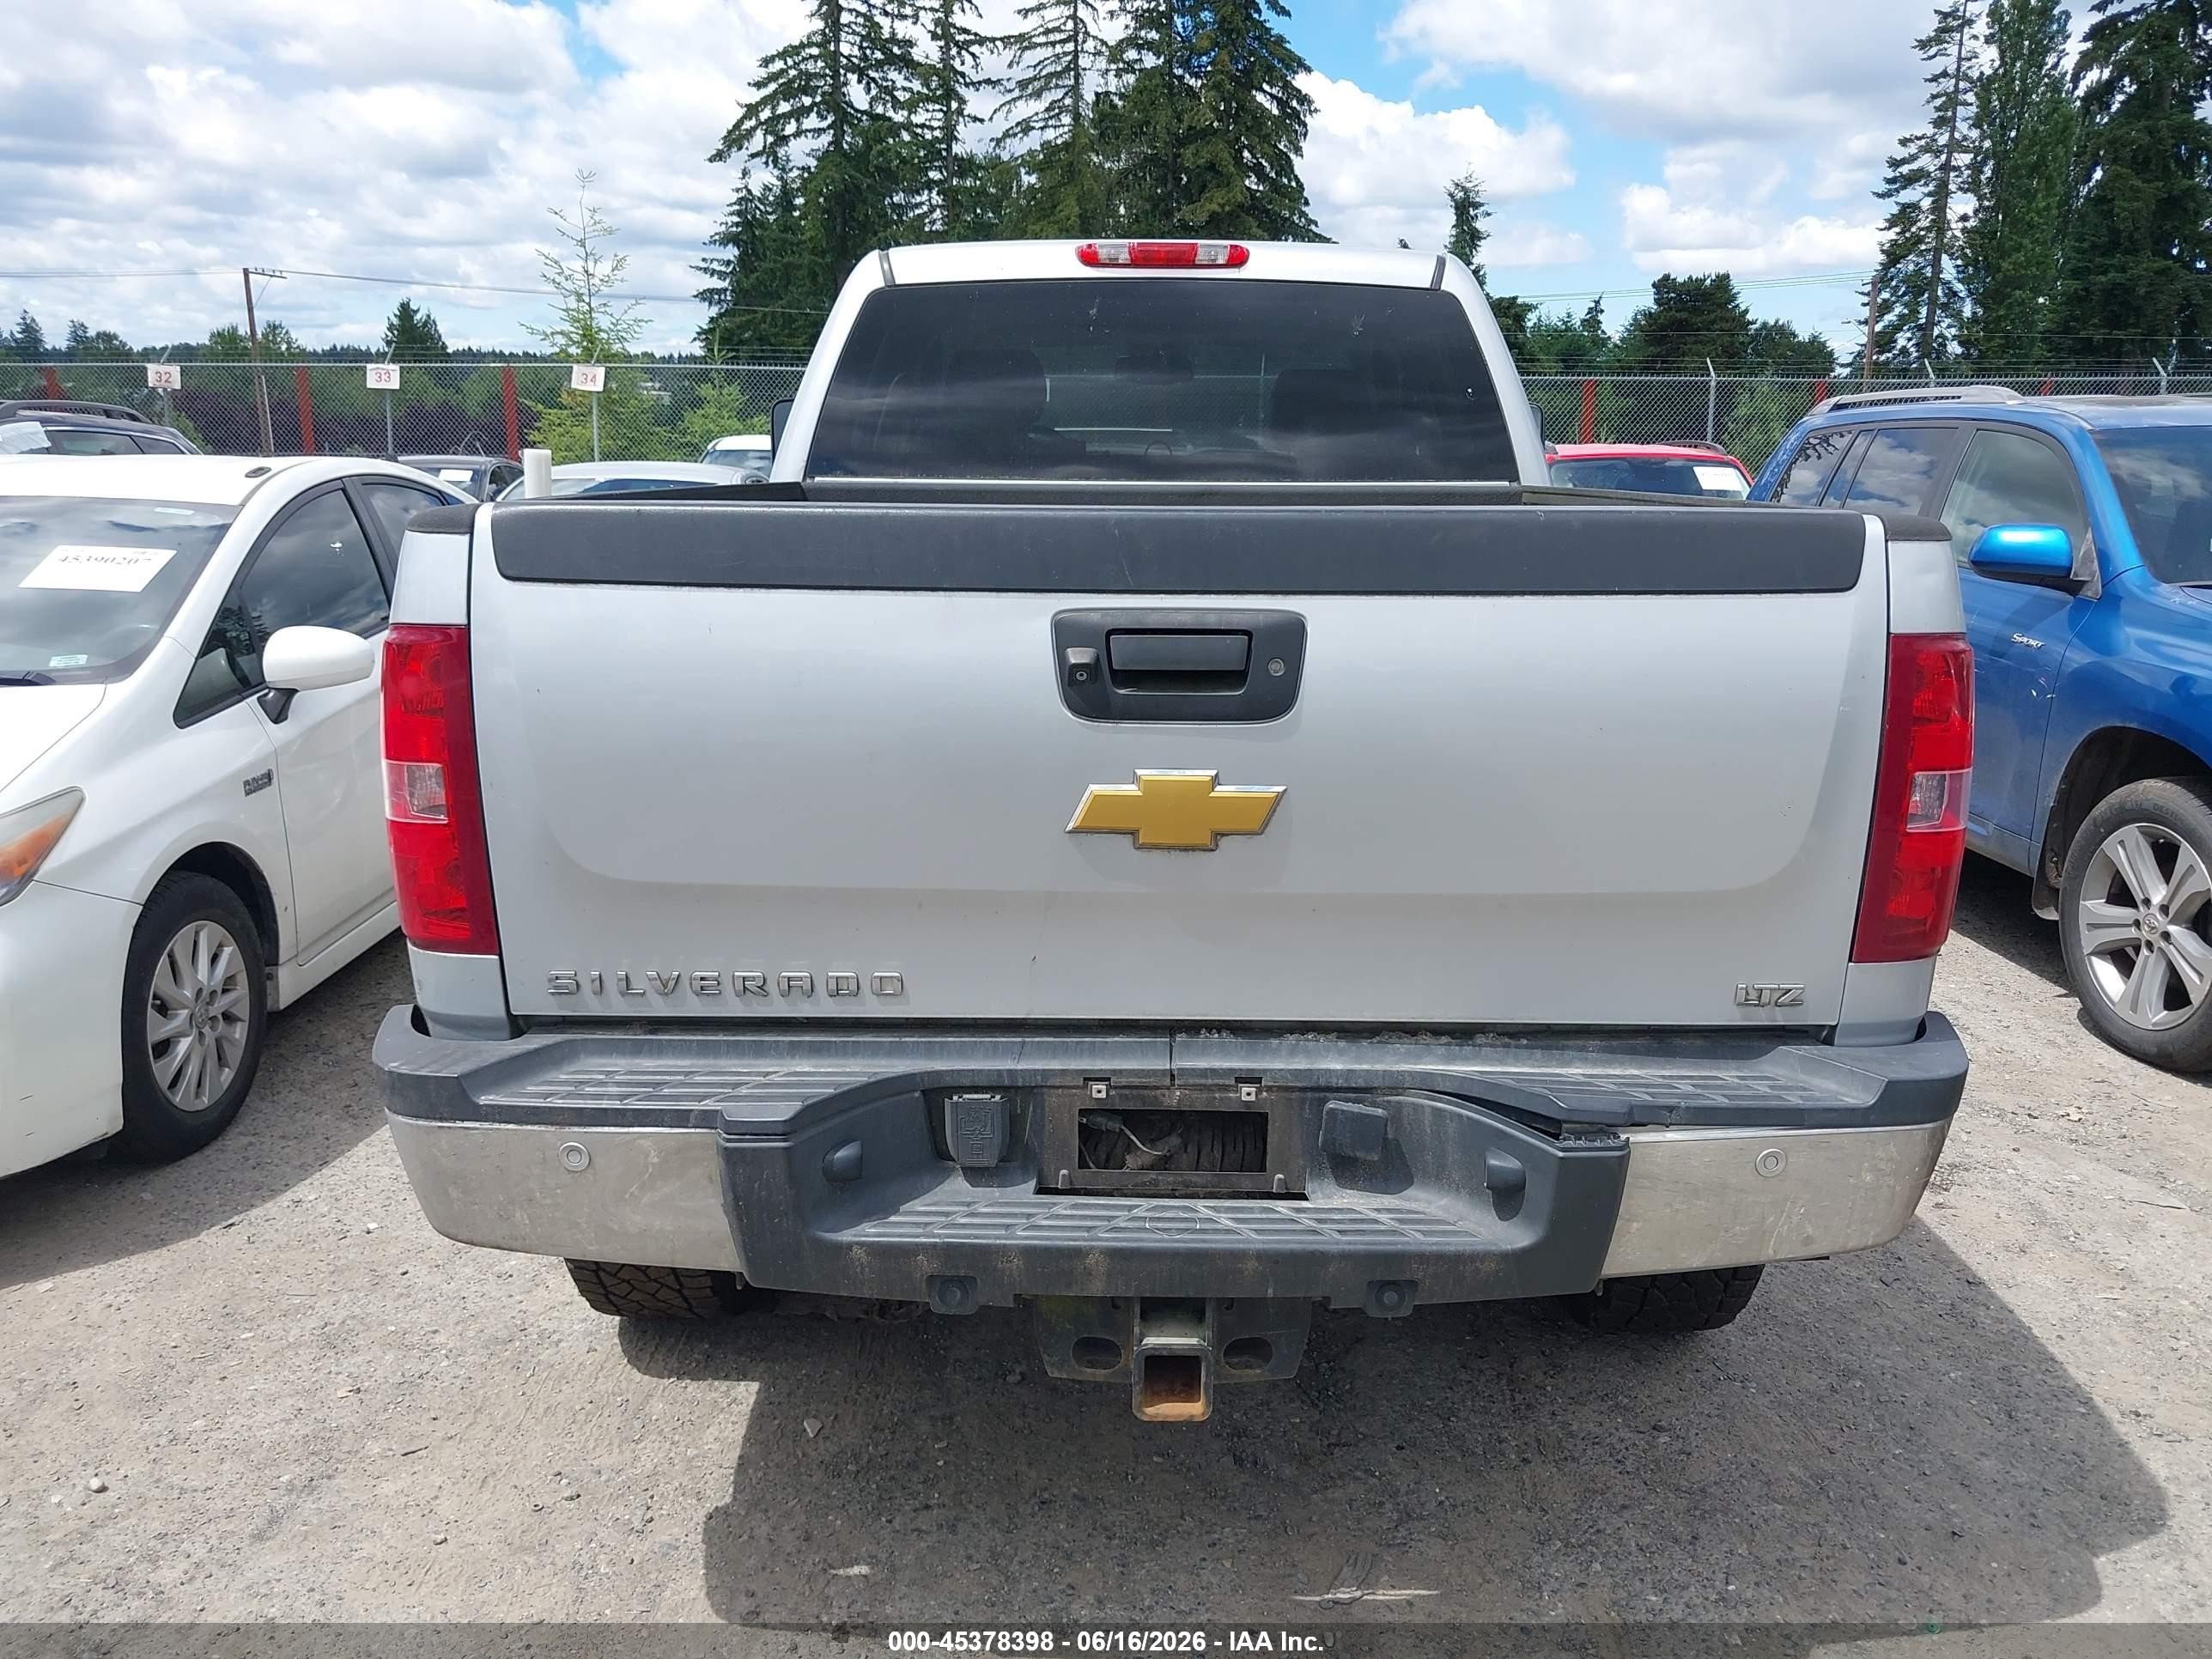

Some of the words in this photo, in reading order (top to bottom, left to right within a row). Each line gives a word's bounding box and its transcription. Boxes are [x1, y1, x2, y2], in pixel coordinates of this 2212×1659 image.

[155, 370, 172, 384] 32
[374, 370, 392, 383] 33
[580, 372, 597, 386] 34
[547, 969, 903, 997] SILVERADO
[1735, 983, 1805, 1007] LTZ
